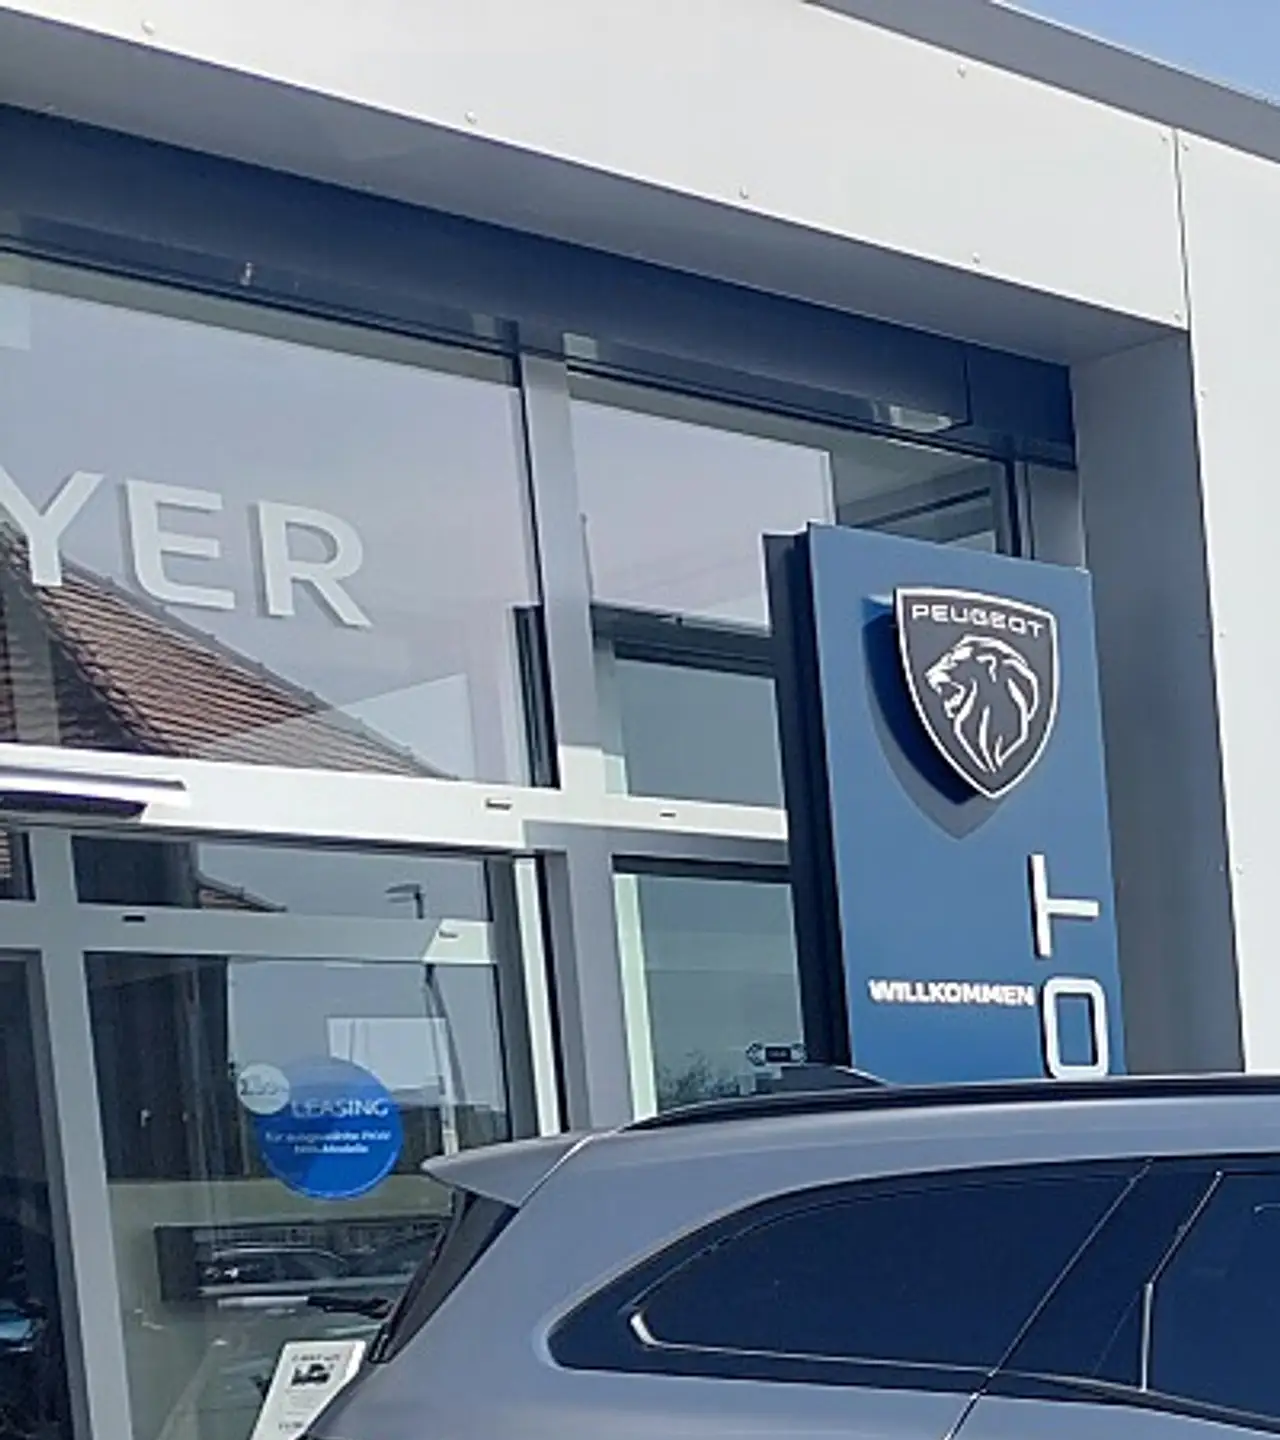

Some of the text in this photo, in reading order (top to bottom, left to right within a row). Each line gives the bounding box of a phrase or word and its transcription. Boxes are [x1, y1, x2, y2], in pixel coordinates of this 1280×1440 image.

[0, 465, 372, 628] YER
[911, 603, 1043, 639] PEUGEOT
[868, 979, 1036, 1007] WILLKOMMEN
[290, 1097, 389, 1119] LEASING
